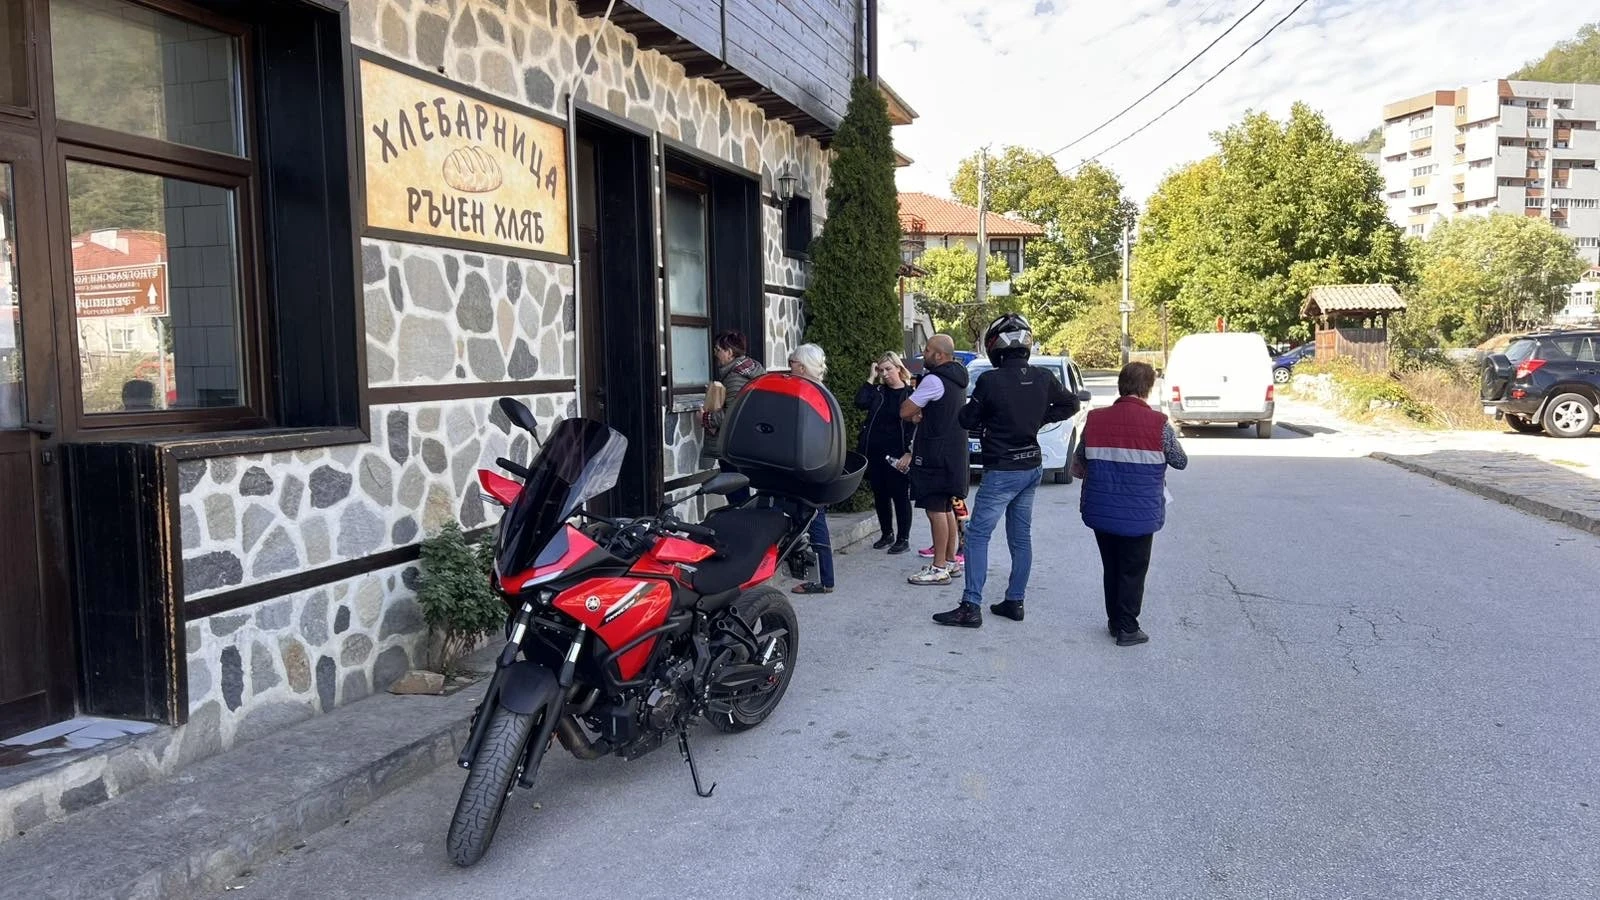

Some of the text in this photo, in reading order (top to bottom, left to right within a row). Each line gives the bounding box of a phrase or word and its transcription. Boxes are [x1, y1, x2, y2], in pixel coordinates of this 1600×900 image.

[372, 97, 558, 200] ХЛЕБАРНИЦА
[406, 187, 545, 245] РЪЧЕН ХЛЯБ
